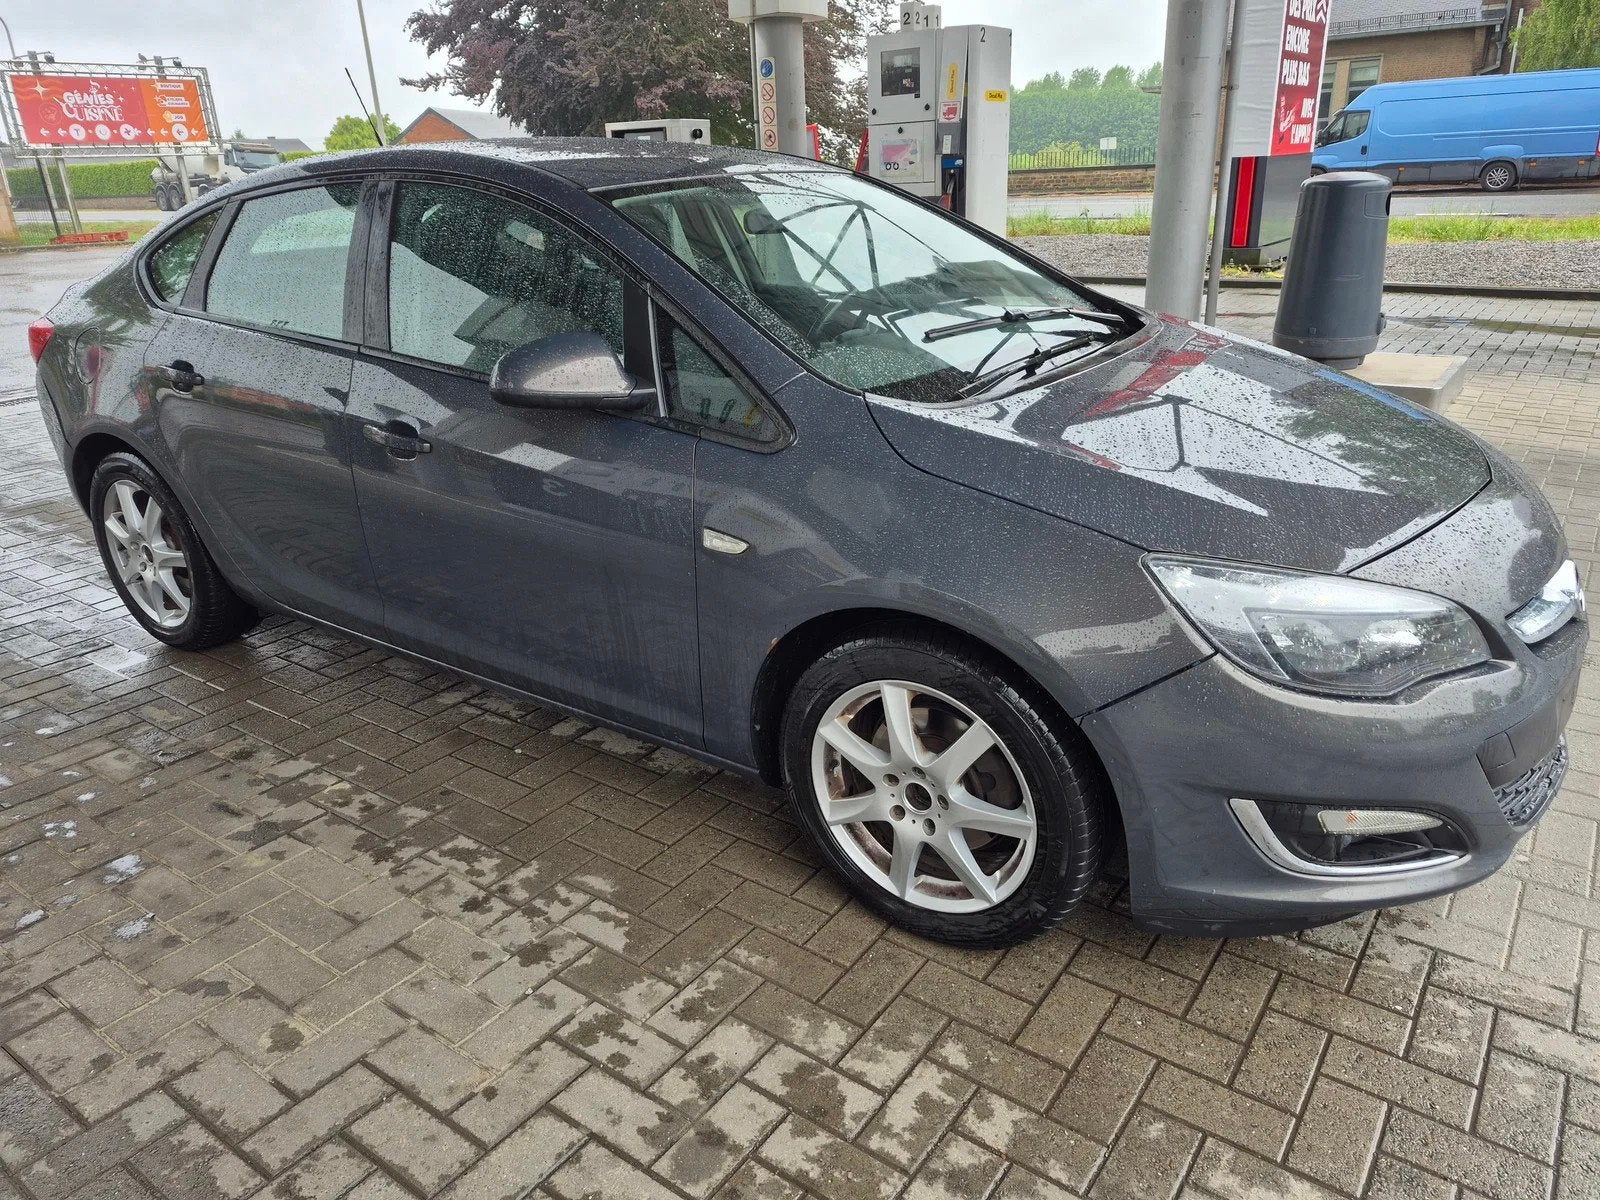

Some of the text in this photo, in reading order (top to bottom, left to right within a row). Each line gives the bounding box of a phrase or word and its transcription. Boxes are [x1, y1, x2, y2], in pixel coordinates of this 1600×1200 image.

[903, 12, 911, 25] 2
[915, 11, 920, 24] 2
[924, 15, 929, 27] 1
[936, 14, 939, 27] 1
[980, 27, 986, 42] 2
[1285, 24, 1311, 54] ENCORE
[1281, 58, 1311, 86] PLUS BAS
[63, 89, 114, 105] GÉNIES
[61, 102, 125, 121] CUISINE
